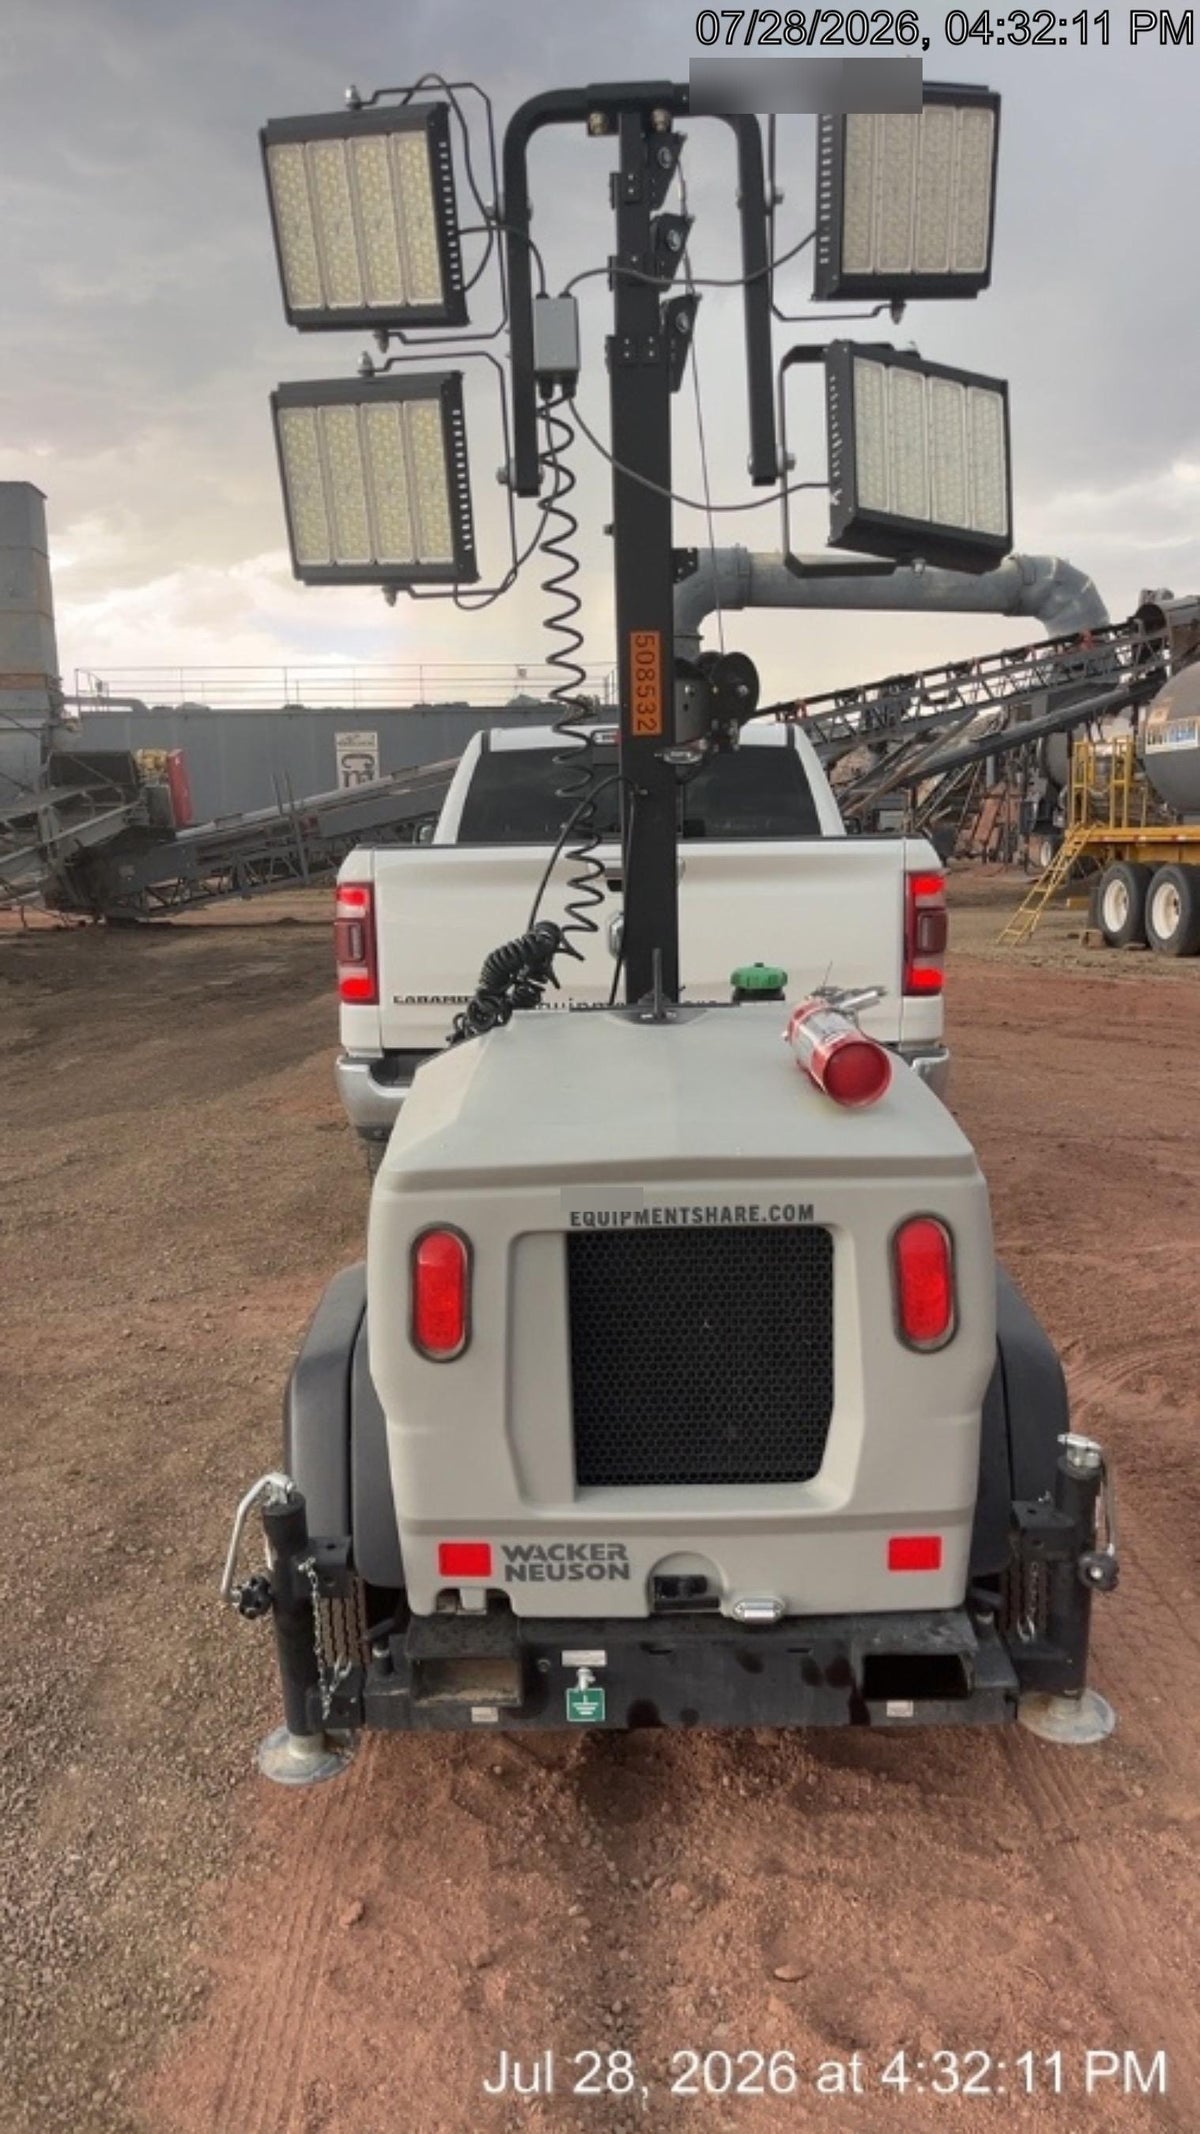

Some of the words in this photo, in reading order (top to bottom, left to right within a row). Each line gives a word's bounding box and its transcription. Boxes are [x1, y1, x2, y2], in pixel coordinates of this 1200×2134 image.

[635, 634, 657, 731] 508532
[570, 1204, 815, 1227] EQUIPMENTSHARE.COM
[501, 1543, 629, 1562] WACKER
[504, 1563, 630, 1582] NEUSON
